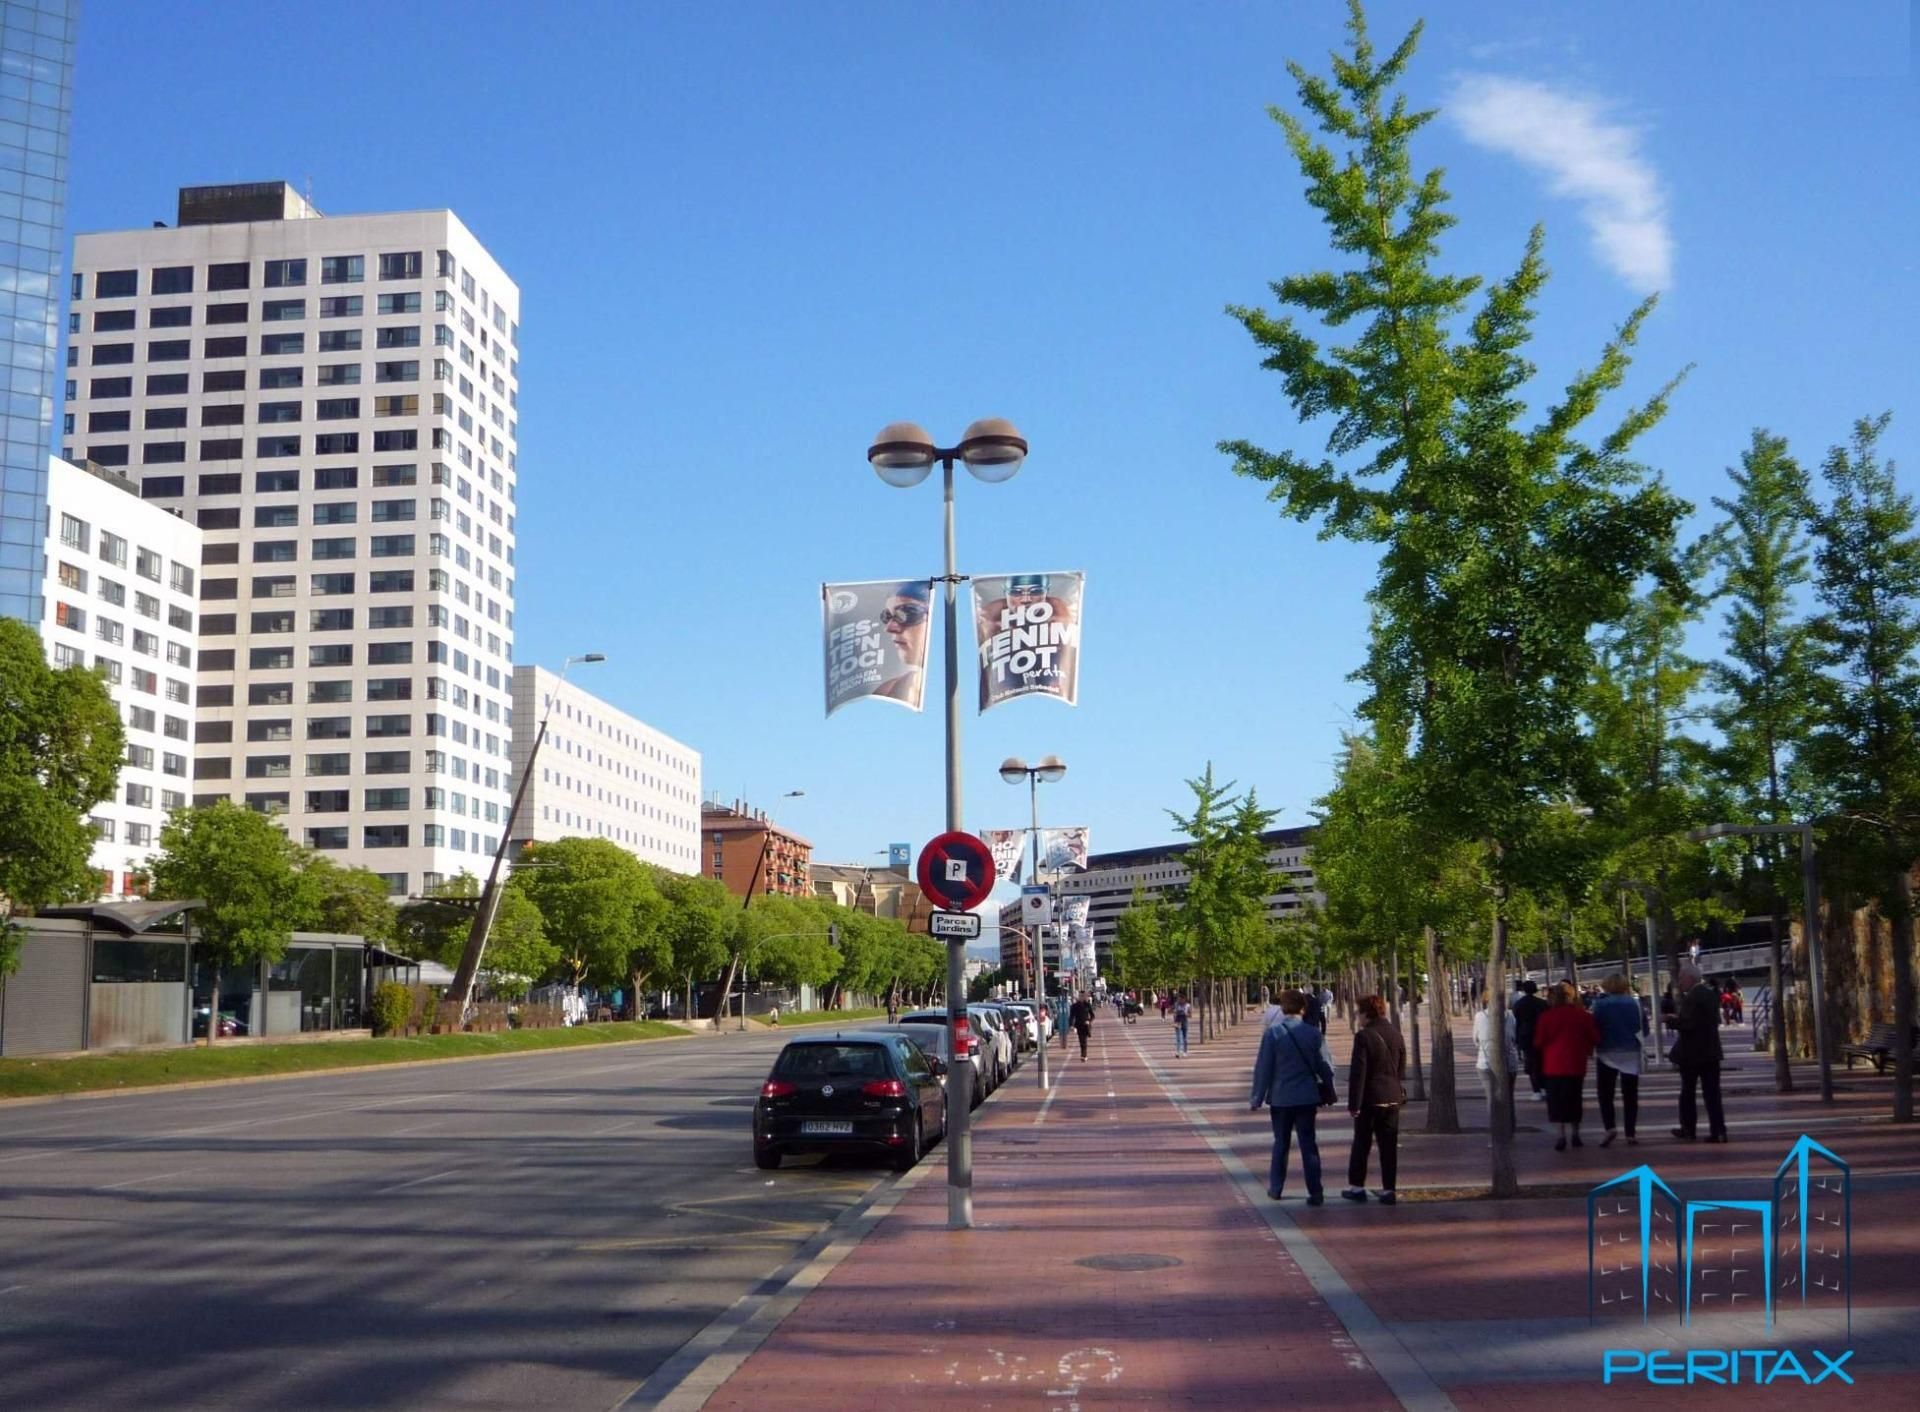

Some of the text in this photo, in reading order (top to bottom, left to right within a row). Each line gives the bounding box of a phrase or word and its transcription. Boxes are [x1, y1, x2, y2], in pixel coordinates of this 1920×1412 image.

[1001, 602, 1053, 630] HO
[829, 619, 880, 649] FES-
[979, 622, 1078, 668] TENIM
[829, 649, 884, 685] SOCI
[992, 646, 1058, 682] TOT
[992, 841, 1014, 853] HO
[952, 864, 961, 877] P
[936, 916, 967, 926] Parcs
[936, 924, 972, 933] jardins
